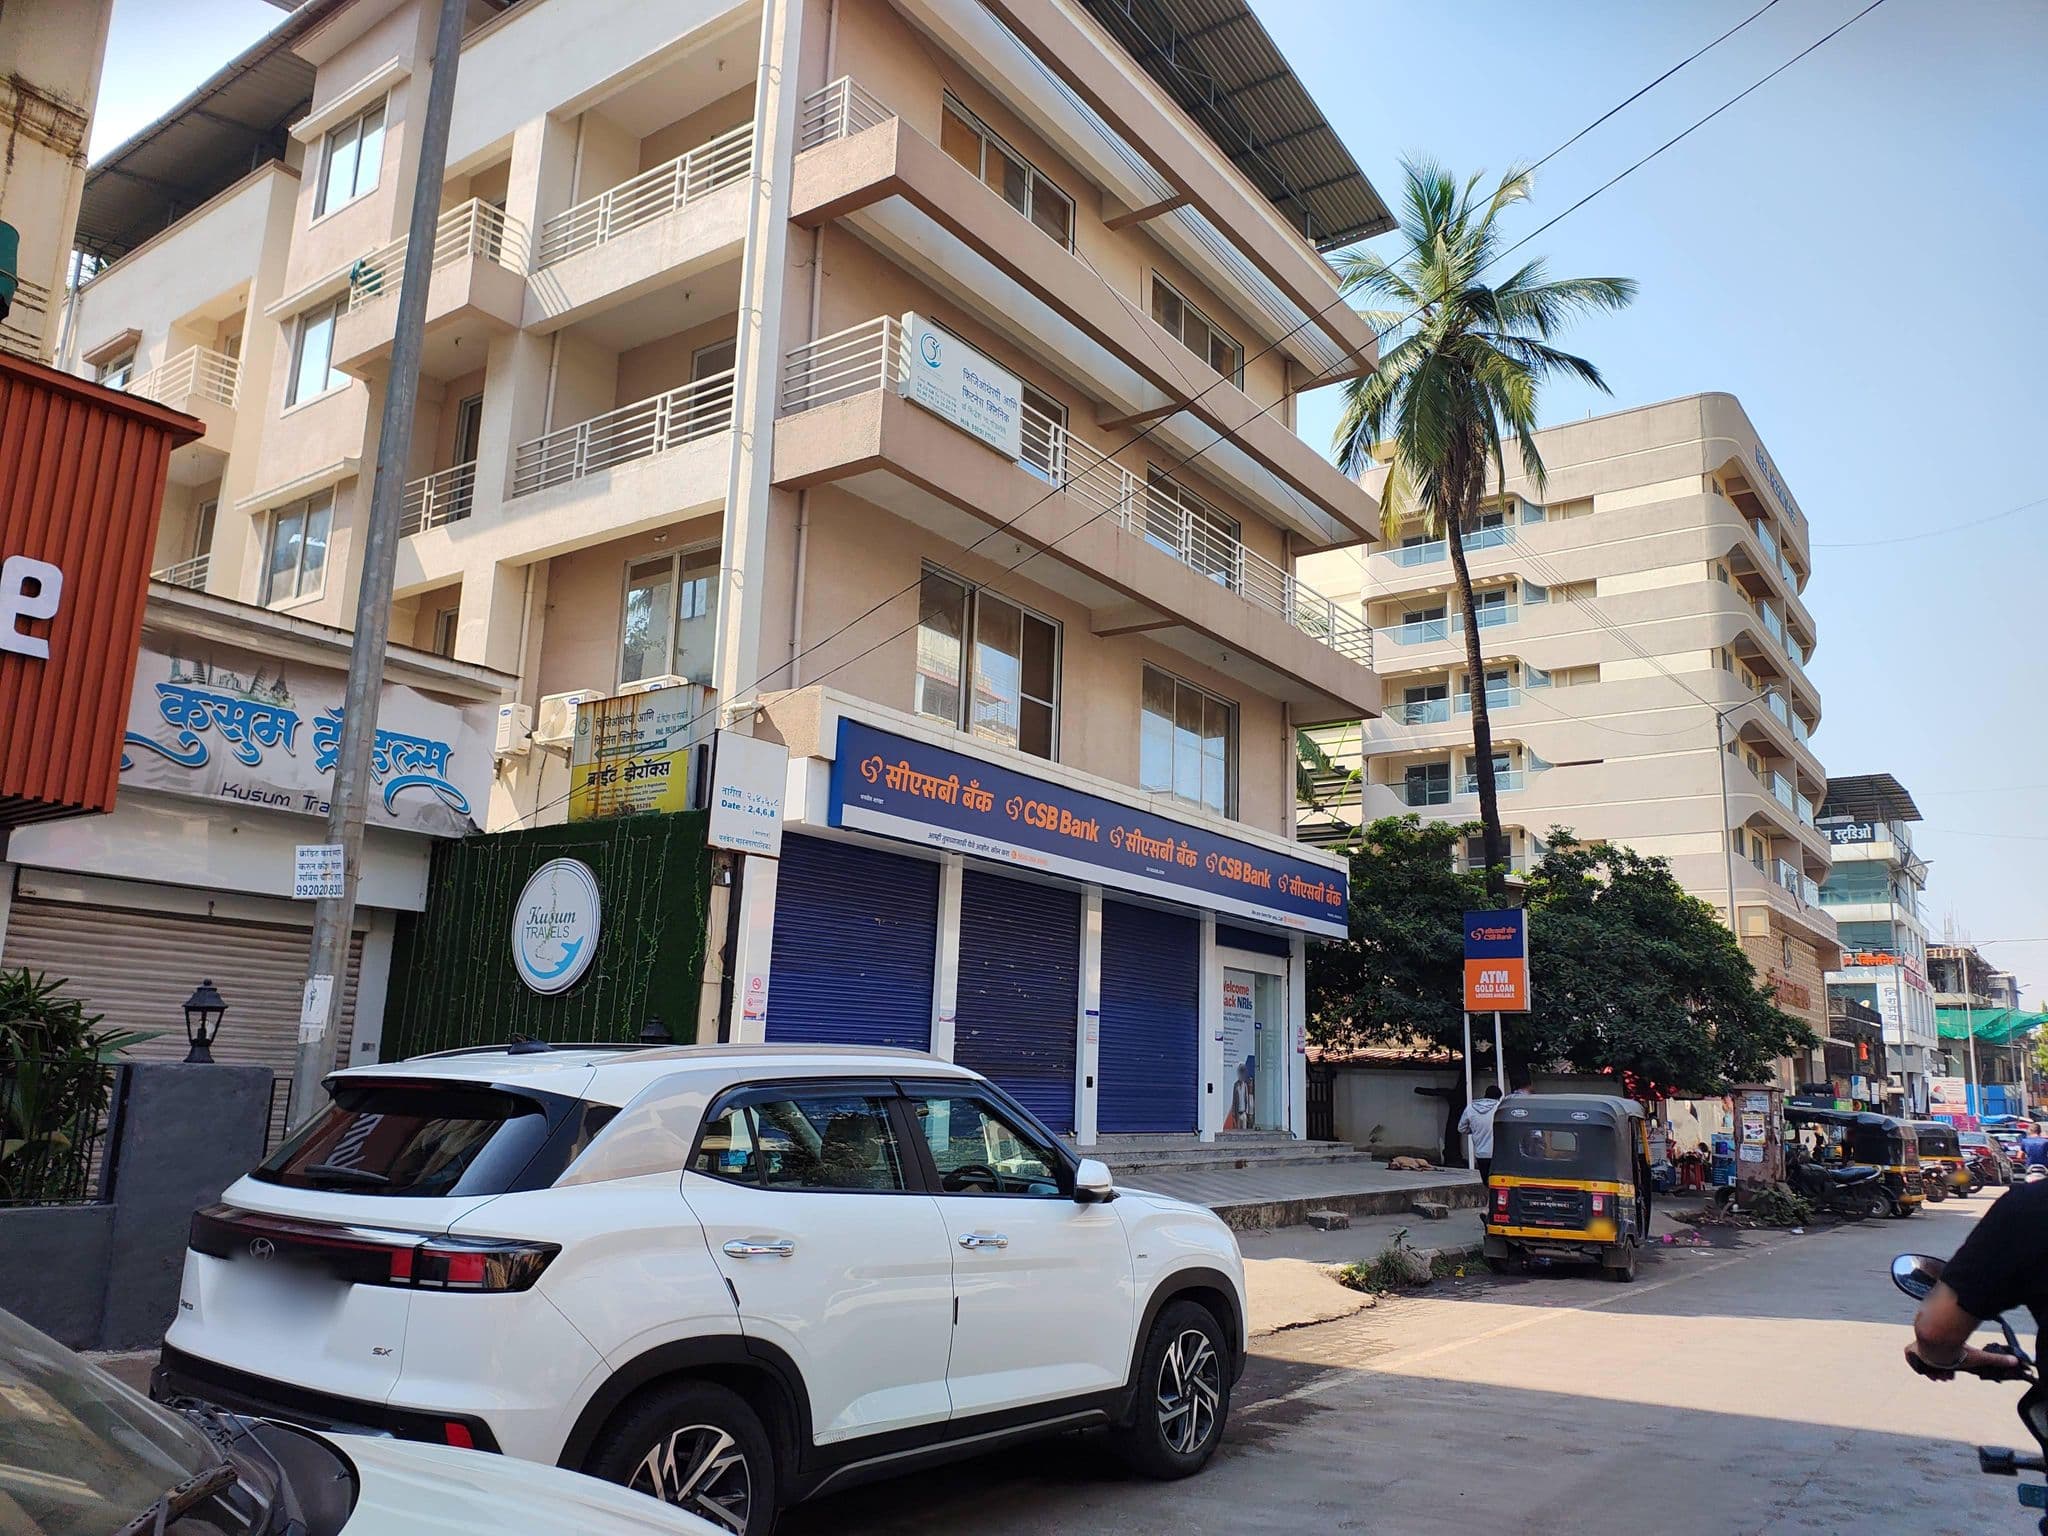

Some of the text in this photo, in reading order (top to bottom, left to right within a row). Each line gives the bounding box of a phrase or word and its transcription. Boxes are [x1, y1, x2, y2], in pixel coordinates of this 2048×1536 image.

[153, 682, 303, 768] कुसुम
[220, 781, 291, 807] Kusum
[885, 760, 996, 813] सीएसबी बँक
[721, 800, 742, 811] Date
[1023, 800, 1101, 843] CSB Bank
[1125, 827, 1174, 863] सीएसबी
[1218, 855, 1273, 889] CSB Bank
[1289, 874, 1325, 905] सीएसबी
[525, 925, 570, 939] TRAVELS
[1480, 970, 1509, 984] ATM
[1223, 980, 1250, 996] elcome
[1474, 984, 1515, 993] GOLD LOAN
[1223, 995, 1237, 1008] ack
[372, 1347, 394, 1357] SX
